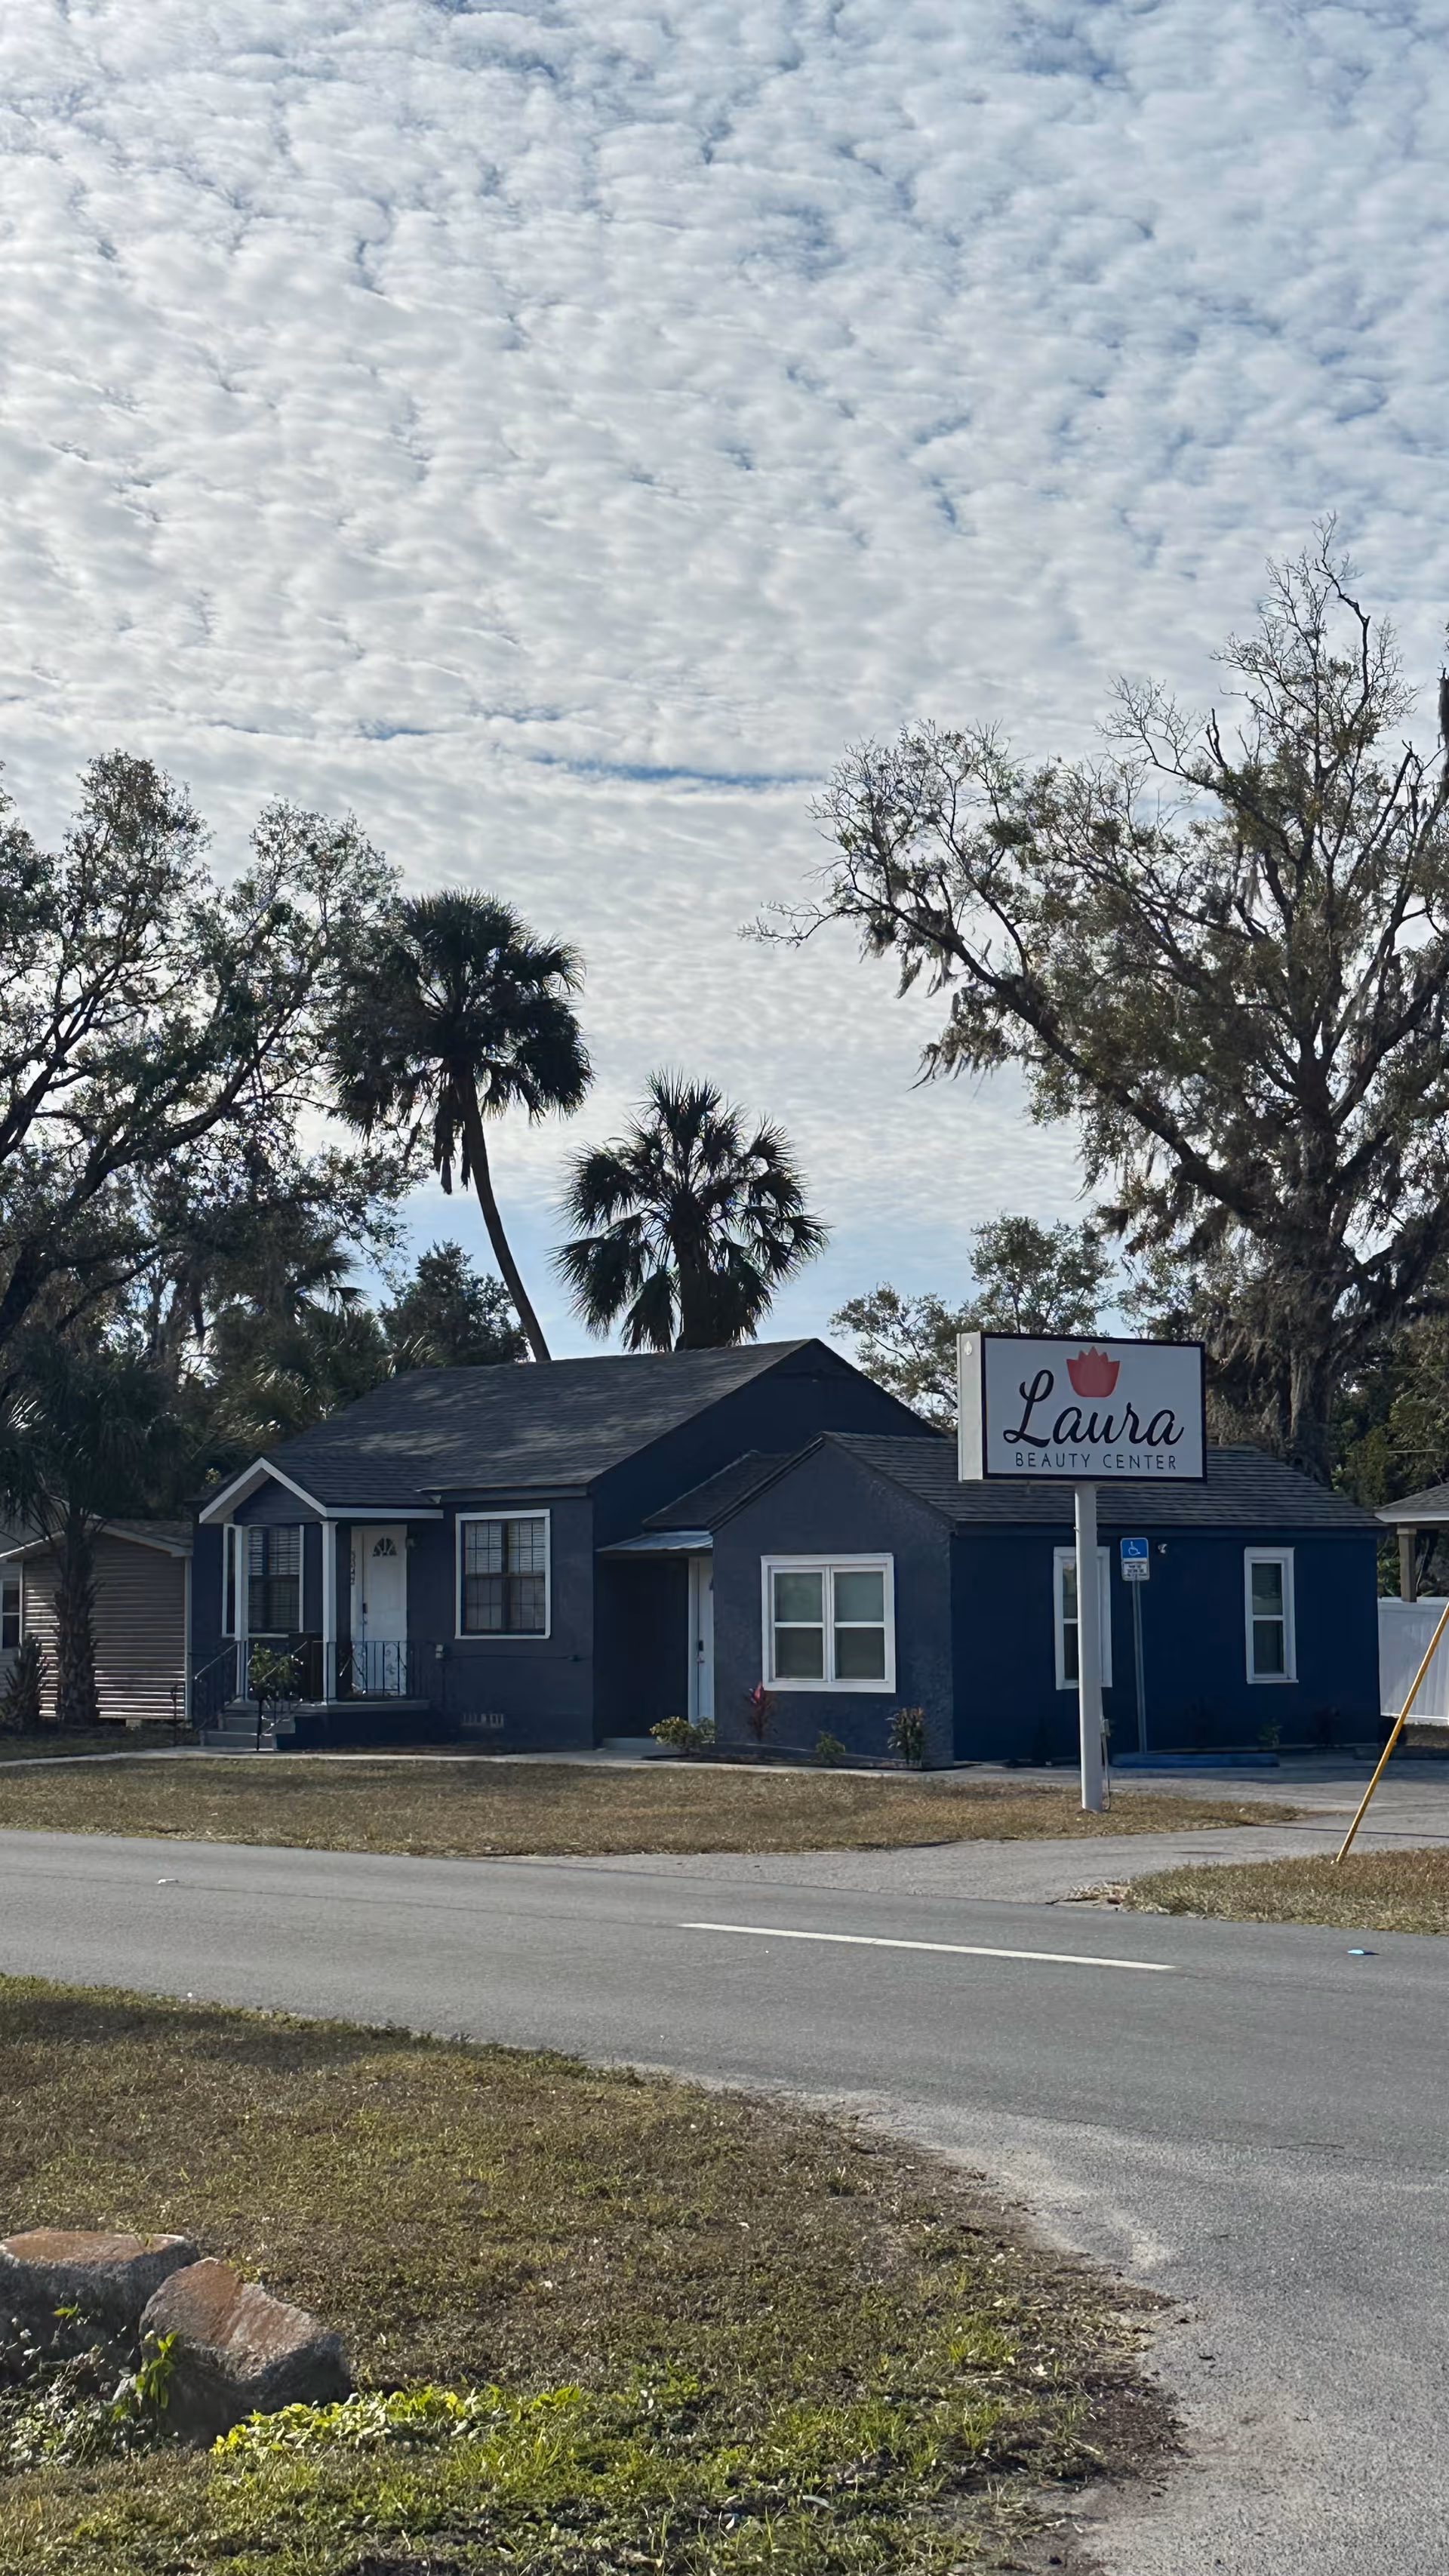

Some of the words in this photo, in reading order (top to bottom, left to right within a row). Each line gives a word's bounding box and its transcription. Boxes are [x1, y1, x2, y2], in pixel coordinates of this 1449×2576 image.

[1003, 1370, 1185, 1448] Laura
[1015, 1452, 1091, 1468] BEAUTY
[1103, 1454, 1177, 1470] CENTER
